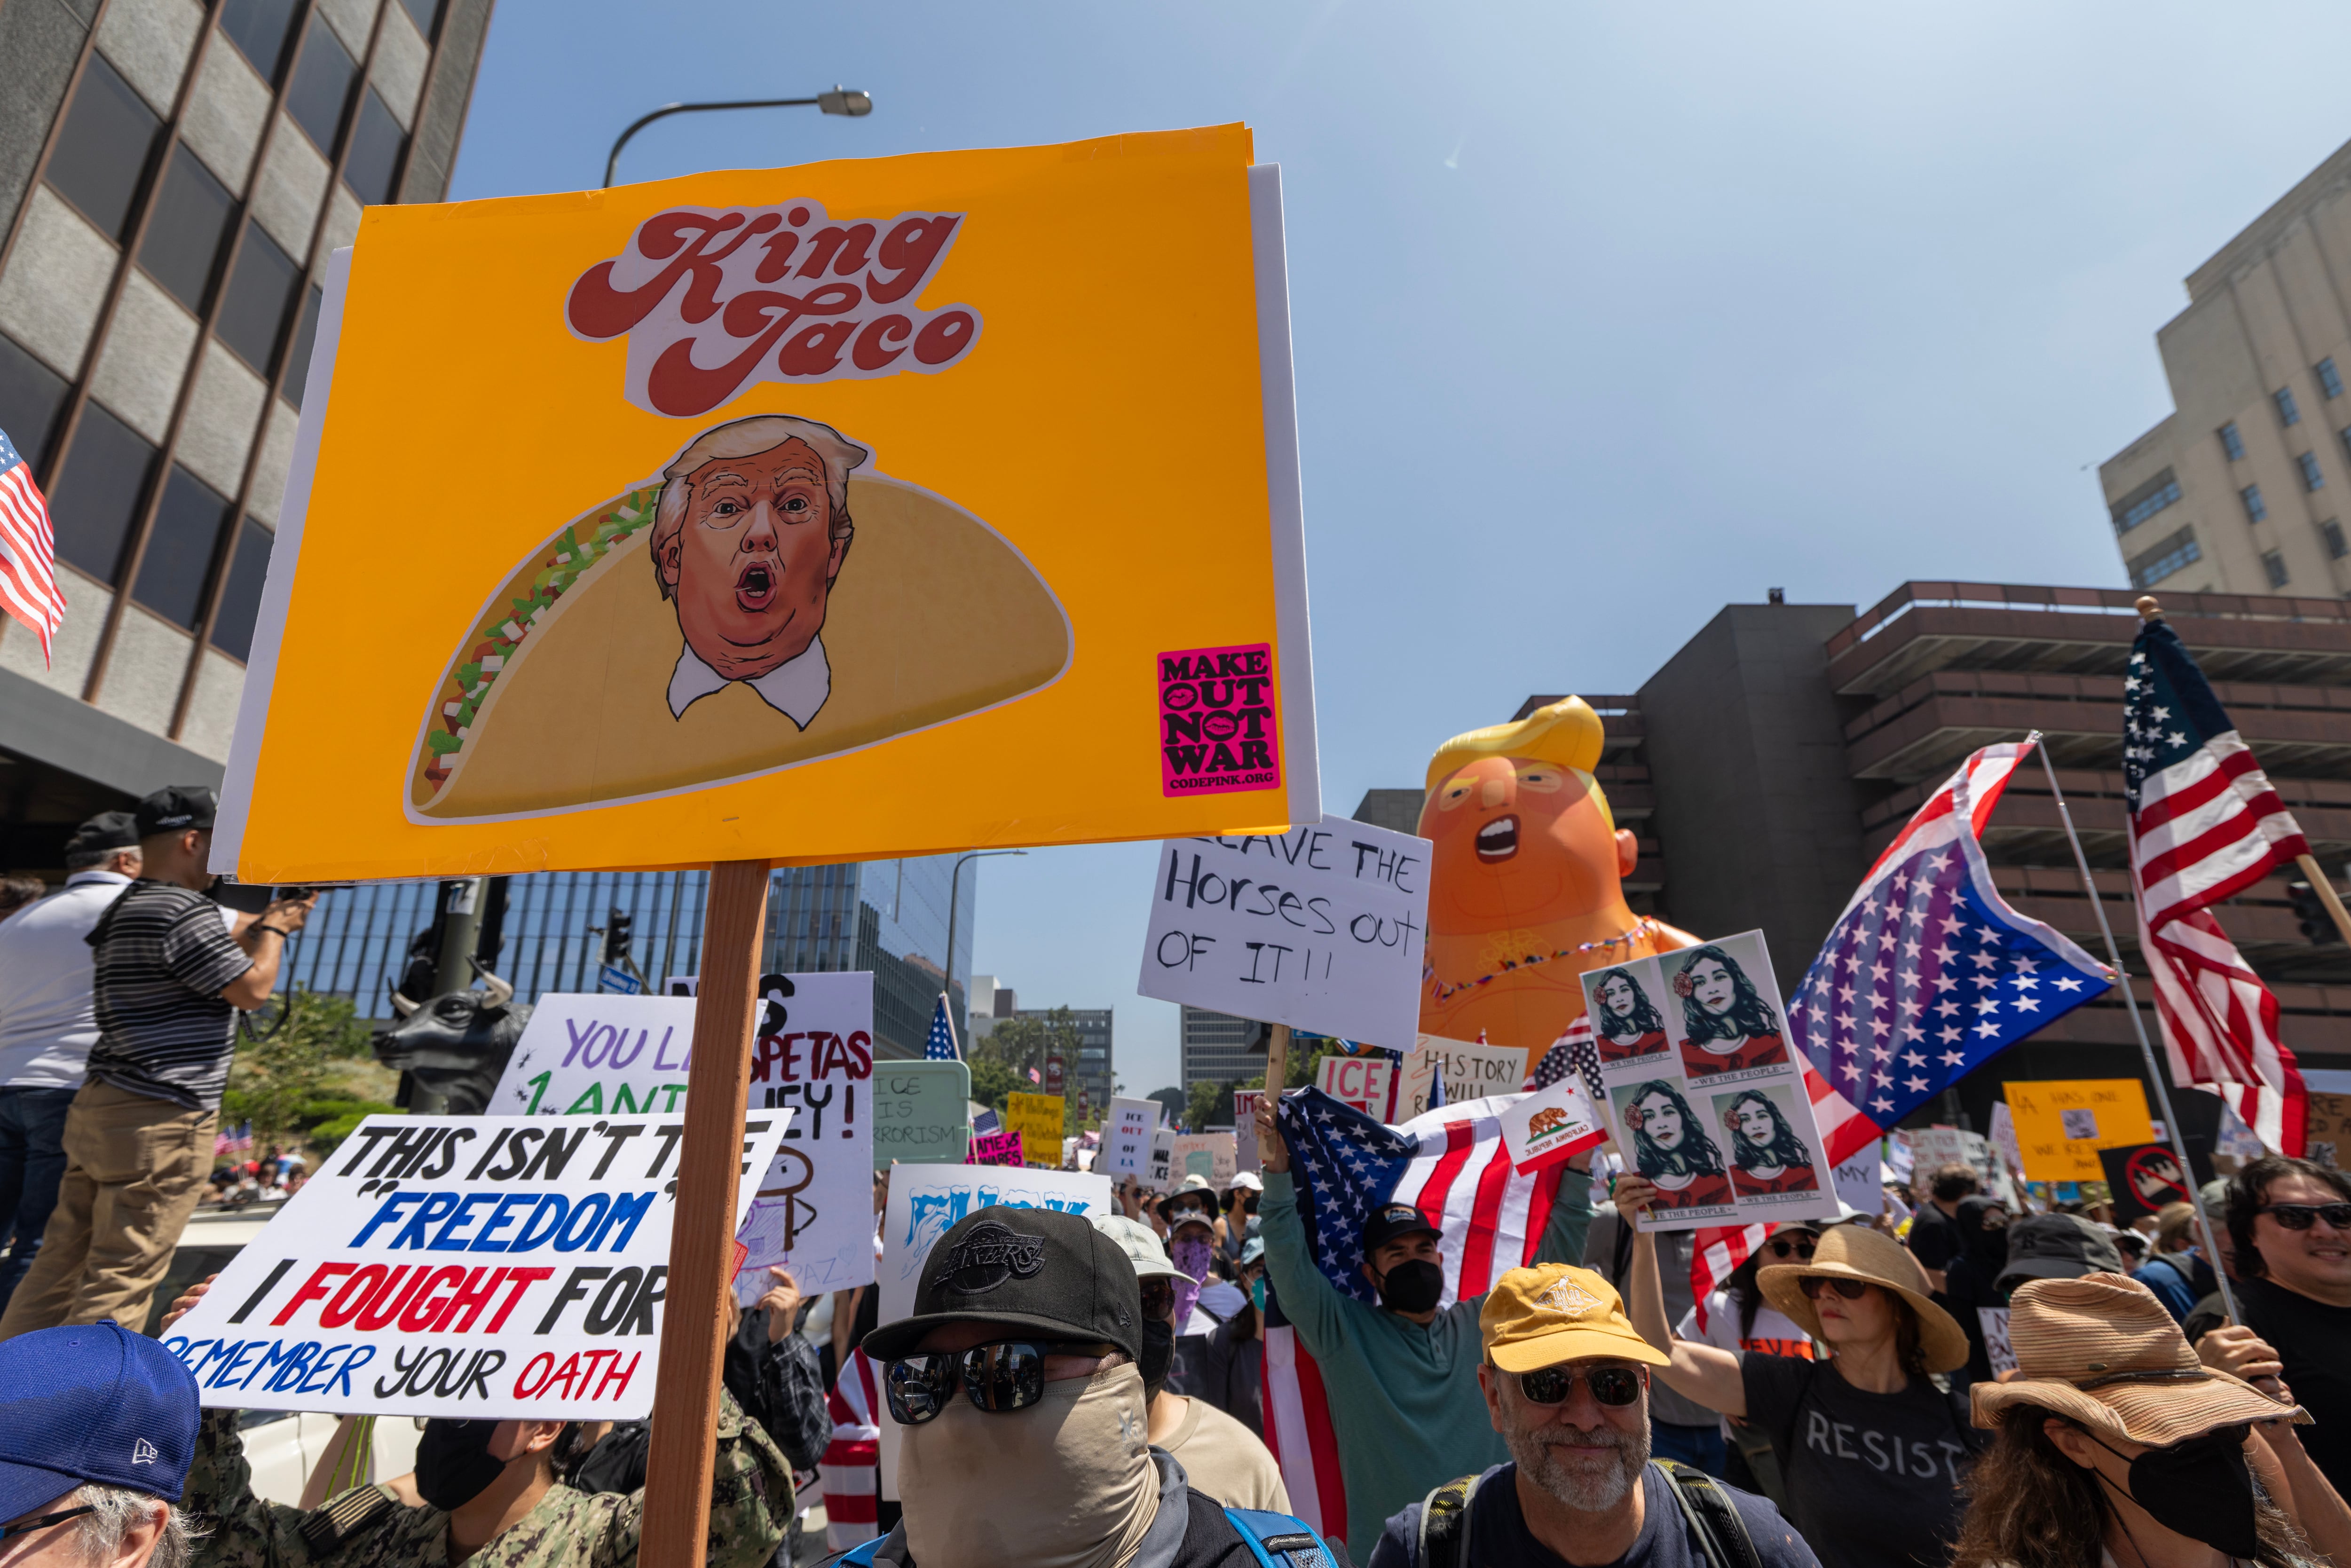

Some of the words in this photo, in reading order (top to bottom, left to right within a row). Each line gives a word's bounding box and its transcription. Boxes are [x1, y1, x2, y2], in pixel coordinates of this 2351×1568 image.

[568, 207, 961, 338] King
[648, 283, 974, 417] Taco
[1161, 651, 1268, 682] MAKE
[1163, 676, 1270, 711] OUT
[1163, 706, 1272, 745] NOT
[1164, 740, 1274, 775] WAR
[1170, 772, 1274, 789] CODEPINK.ORG
[1352, 841, 1421, 893] THE
[1157, 930, 1216, 972] OF
[561, 1018, 647, 1070] YOU
[1326, 1060, 1383, 1099] ICE
[1425, 1050, 1517, 1084] HISTORY
[1698, 1077, 1716, 1085] WE
[1718, 1073, 1738, 1081] THE
[1740, 1066, 1780, 1079] PEOPLE
[873, 1076, 921, 1095] ICE
[878, 1101, 913, 1119] IS
[1126, 1113, 1144, 1122] ICE
[1121, 1126, 1144, 1136] OUT
[1122, 1144, 1137, 1153] OF
[338, 1126, 477, 1179] THIS
[465, 1120, 646, 1181] ISN'T
[1120, 1158, 1134, 1167] LA
[1667, 1209, 1687, 1218] THE
[1688, 1206, 1726, 1217] PEOPLE
[228, 1259, 297, 1324] I
[269, 1261, 556, 1334] FOUGHT
[534, 1265, 668, 1336] FOR
[1551, 1289, 1582, 1302] TAYLOR
[375, 1345, 506, 1399] YOUR
[513, 1349, 641, 1402] OATH
[1807, 1411, 1963, 1484] RESIST
